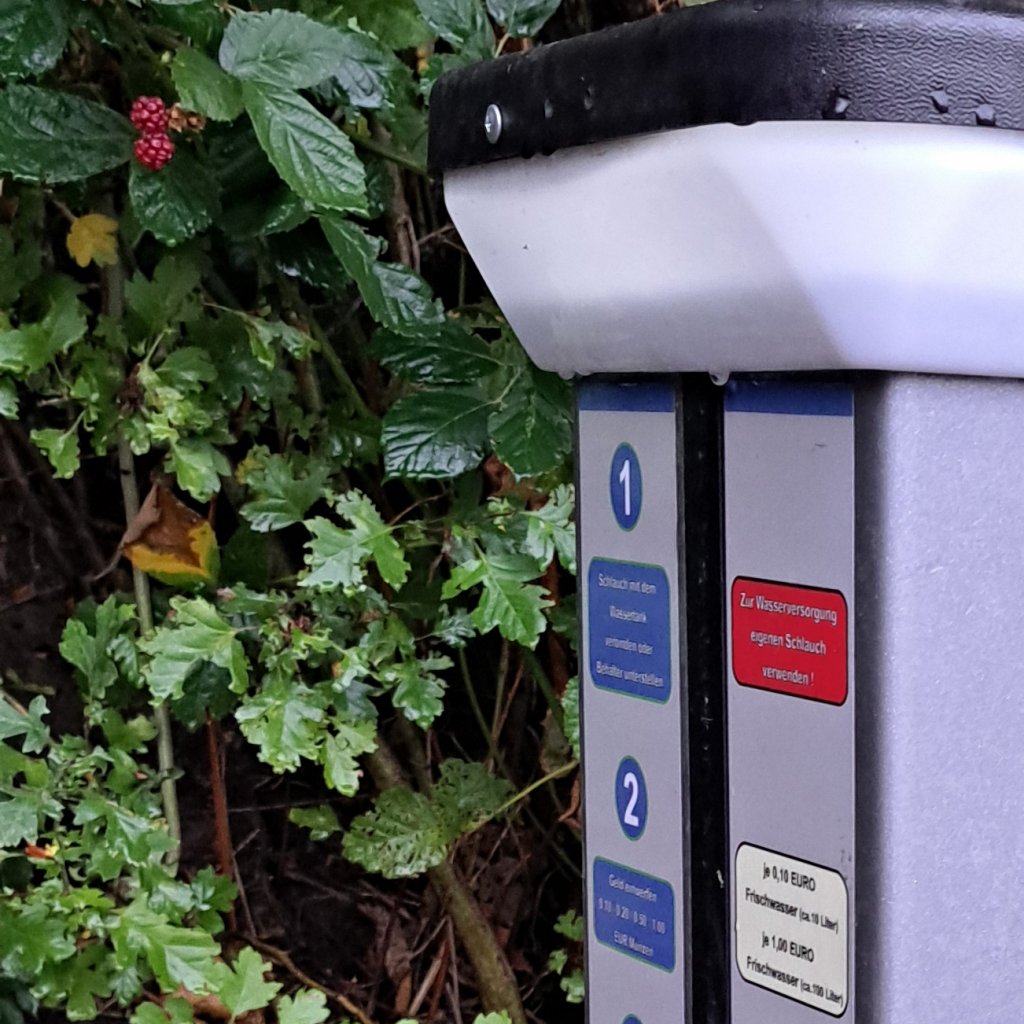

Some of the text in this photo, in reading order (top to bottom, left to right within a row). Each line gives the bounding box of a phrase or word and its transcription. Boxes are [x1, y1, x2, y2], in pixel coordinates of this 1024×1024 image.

[618, 458, 632, 517] 1
[740, 591, 838, 627] Zur Wasserversorgung
[750, 630, 827, 656] eigenen Schlauch
[762, 666, 809, 687] verwenden
[622, 771, 640, 828] 2
[762, 861, 817, 893] je 0,10 EURO
[745, 886, 798, 919] Frischwasser
[761, 930, 769, 949] je
[789, 940, 815, 963] EURO
[746, 955, 799, 988] Frischwasser
